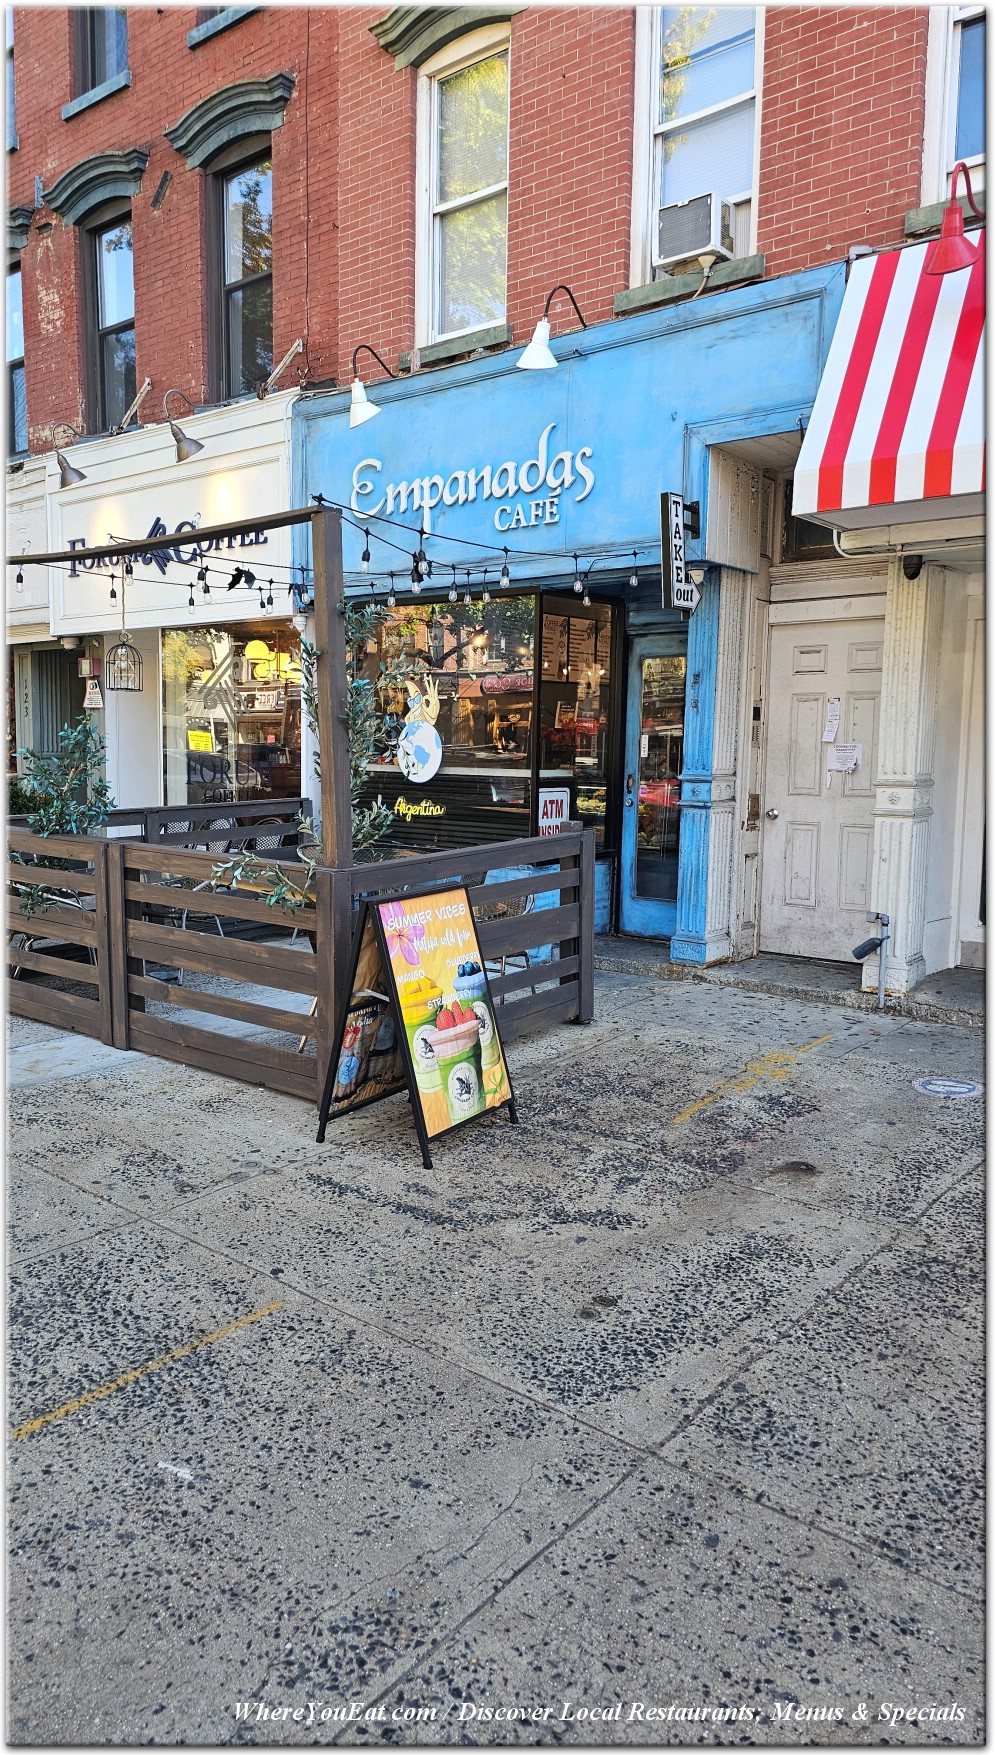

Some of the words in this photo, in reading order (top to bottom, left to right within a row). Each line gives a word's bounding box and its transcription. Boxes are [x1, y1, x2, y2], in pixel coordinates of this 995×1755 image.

[350, 422, 595, 539] Empanadas
[493, 487, 560, 532] CAFÉ
[672, 500, 683, 583] TAKE
[675, 587, 694, 602] out
[394, 796, 446, 822] Argentina
[541, 799, 564, 820] ATM
[538, 825, 561, 836] INSID
[387, 909, 433, 931] SUMMER
[434, 903, 466, 921] VIBES
[396, 970, 426, 985] MANGO
